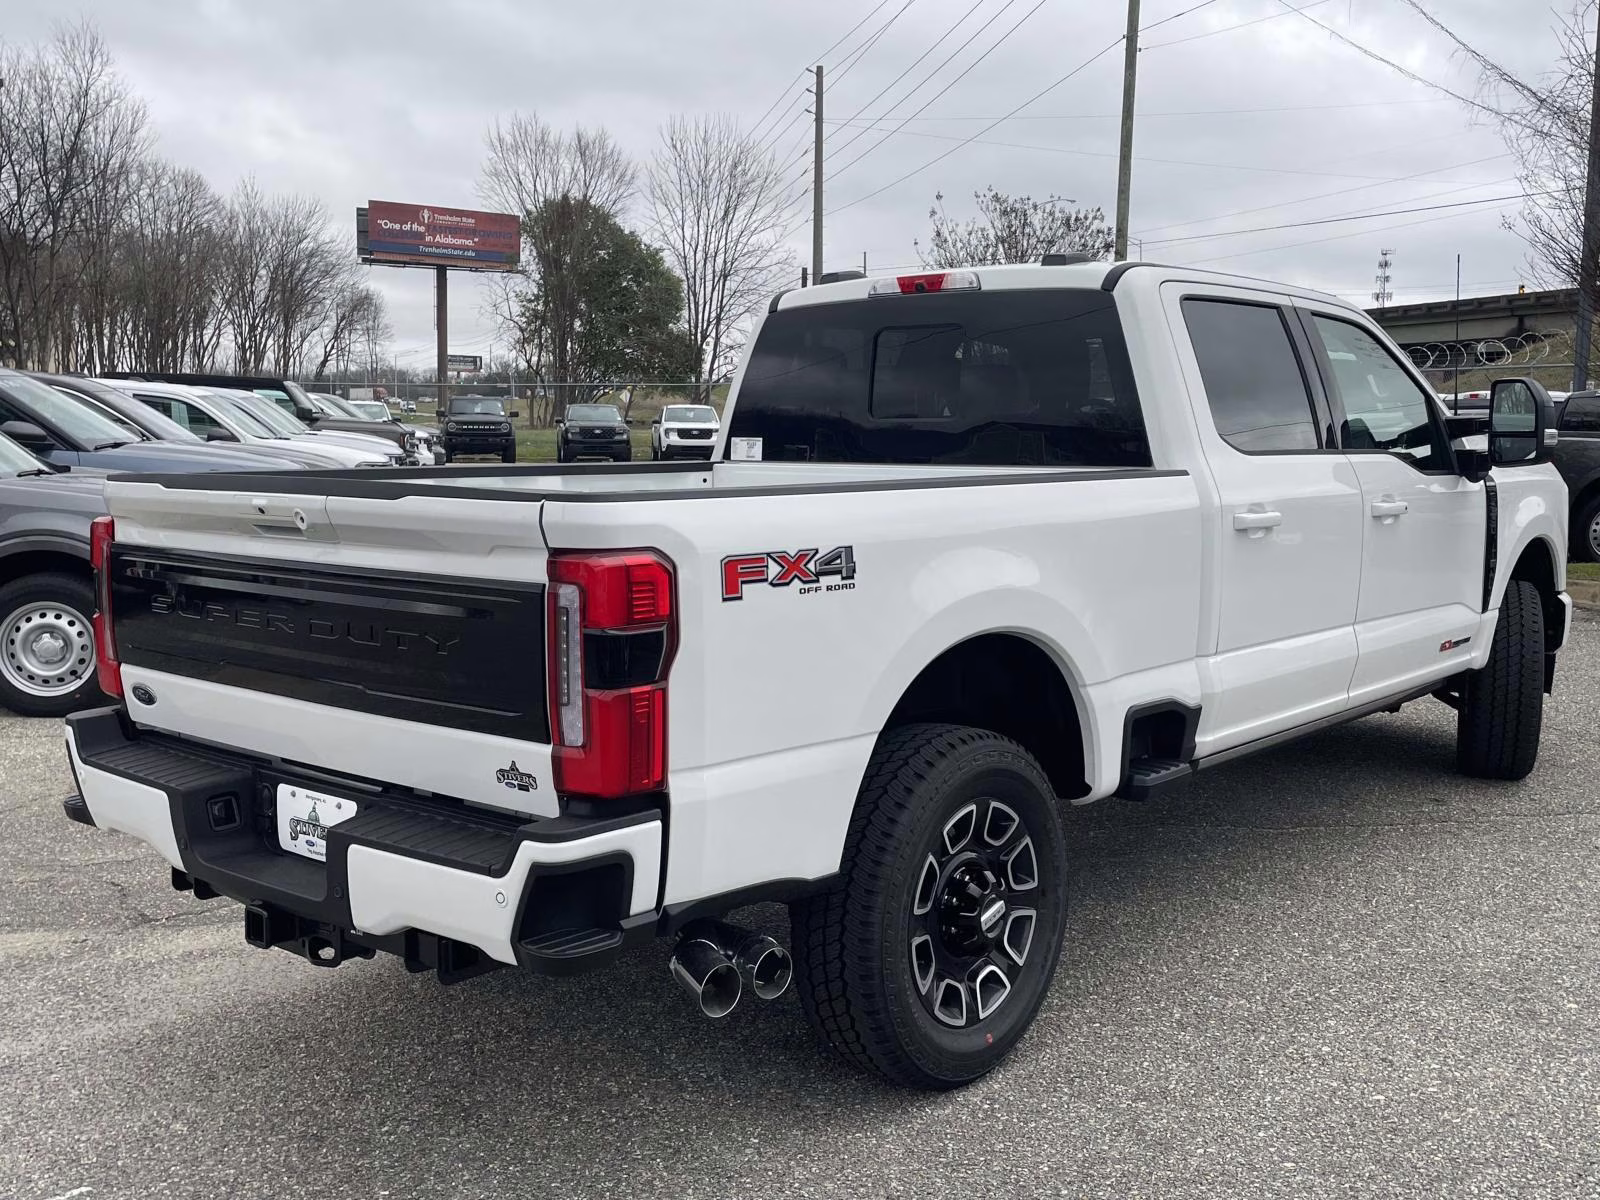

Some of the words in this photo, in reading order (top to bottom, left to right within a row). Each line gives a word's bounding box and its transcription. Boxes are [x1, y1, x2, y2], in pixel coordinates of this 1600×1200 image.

[434, 214, 461, 222] Trenholm
[402, 221, 411, 231] of
[412, 222, 425, 232] the
[425, 232, 433, 242] in
[419, 246, 476, 257] TrenholmState.edu
[720, 545, 856, 602] FX4
[799, 586, 822, 595] OFF
[825, 583, 856, 592] ROAD
[150, 594, 296, 634] SUPER
[308, 618, 461, 656] DUTY
